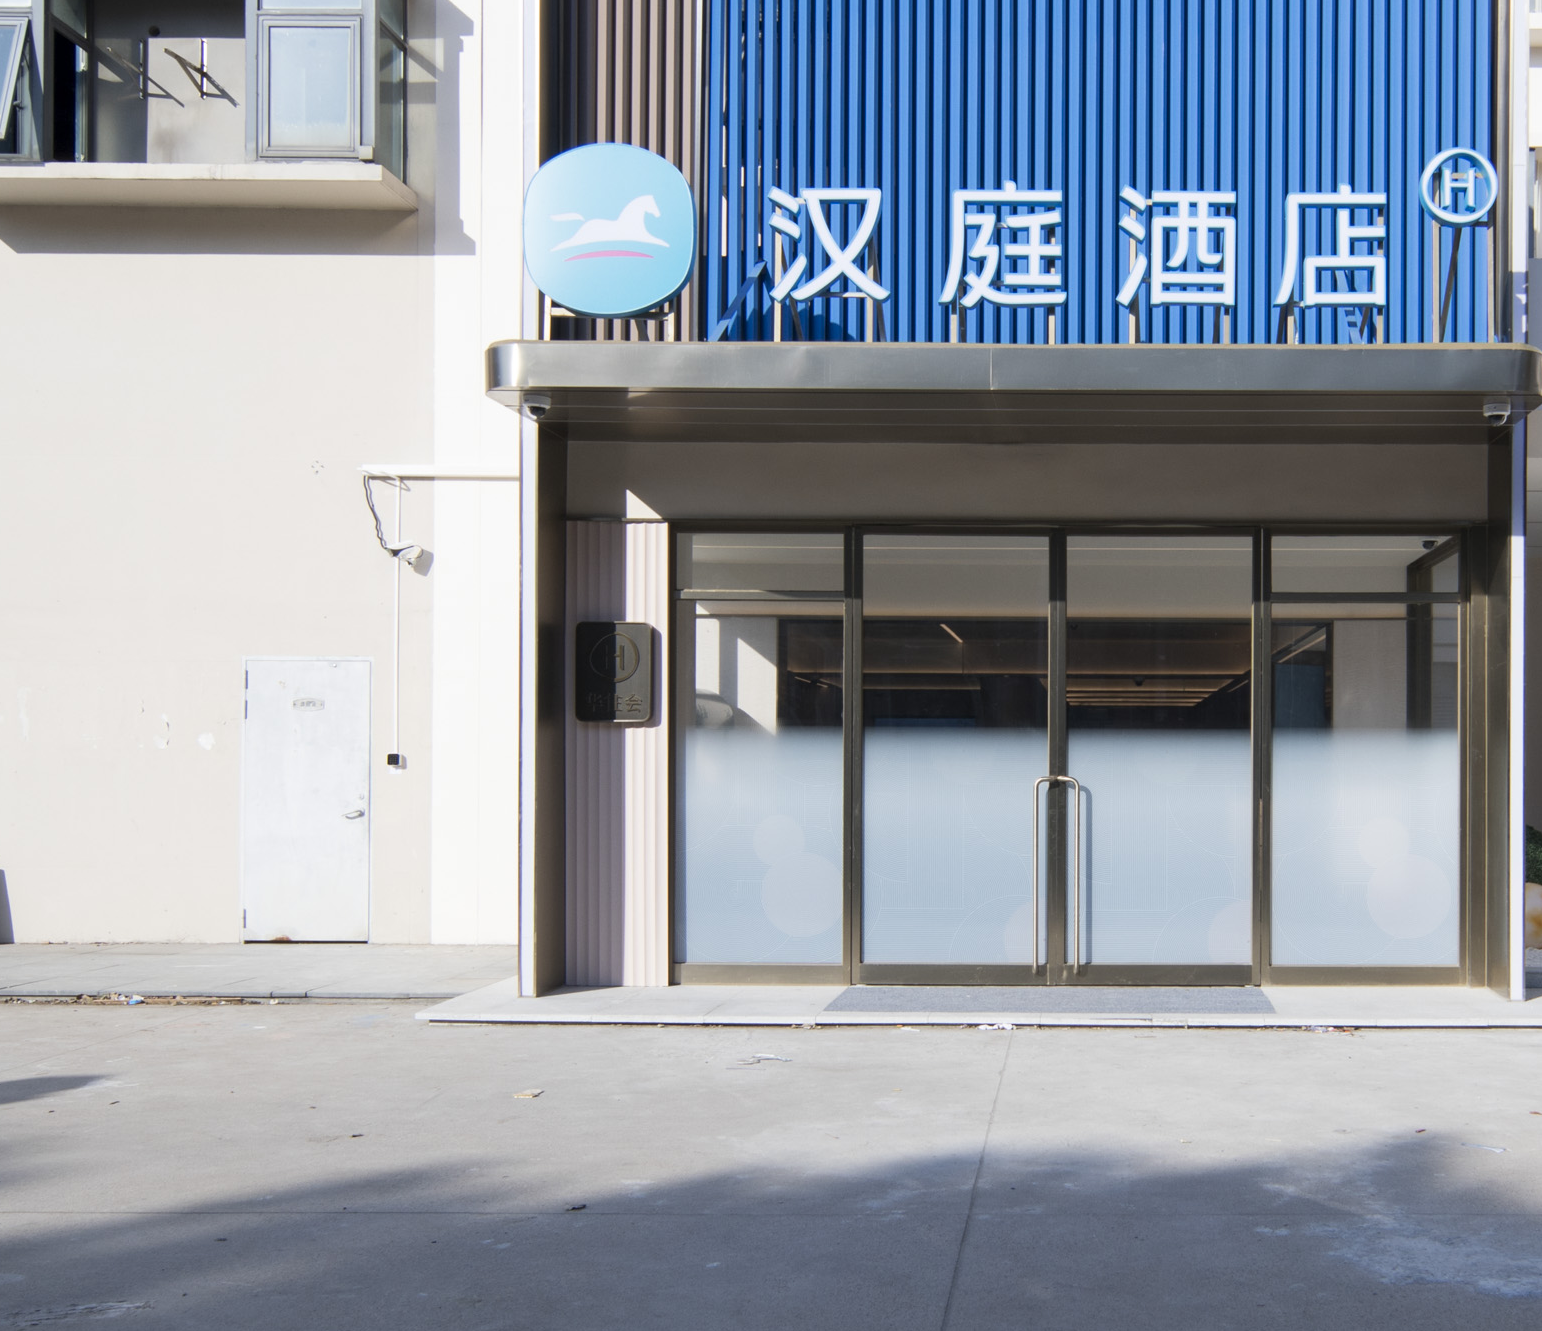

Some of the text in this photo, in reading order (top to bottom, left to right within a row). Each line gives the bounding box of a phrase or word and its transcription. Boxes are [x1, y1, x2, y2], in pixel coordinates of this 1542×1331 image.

[768, 180, 1387, 308] 汉庭酒店
[586, 693, 643, 713] 华住会
